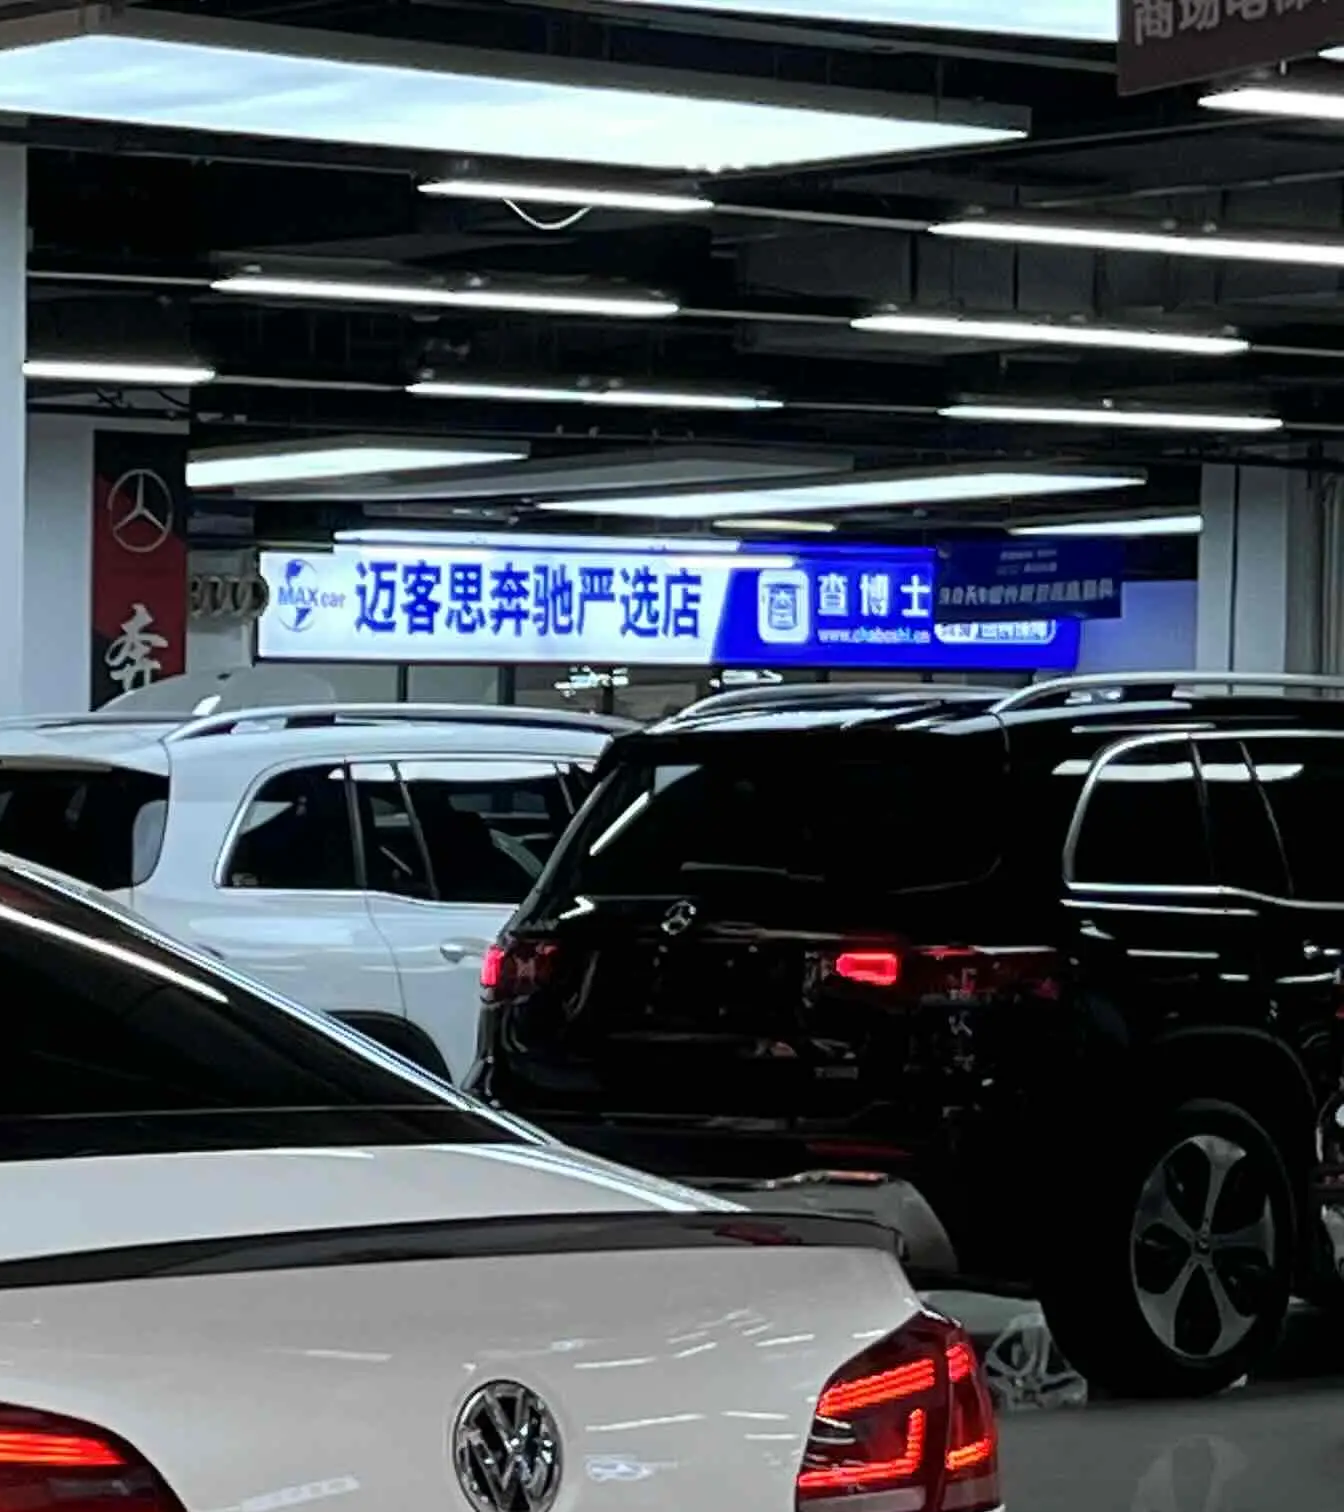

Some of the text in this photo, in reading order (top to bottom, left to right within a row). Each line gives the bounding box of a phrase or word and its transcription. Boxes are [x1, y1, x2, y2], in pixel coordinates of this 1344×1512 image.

[355, 559, 703, 639] 迈客思奔驰严选店
[817, 573, 932, 617] 查博士
